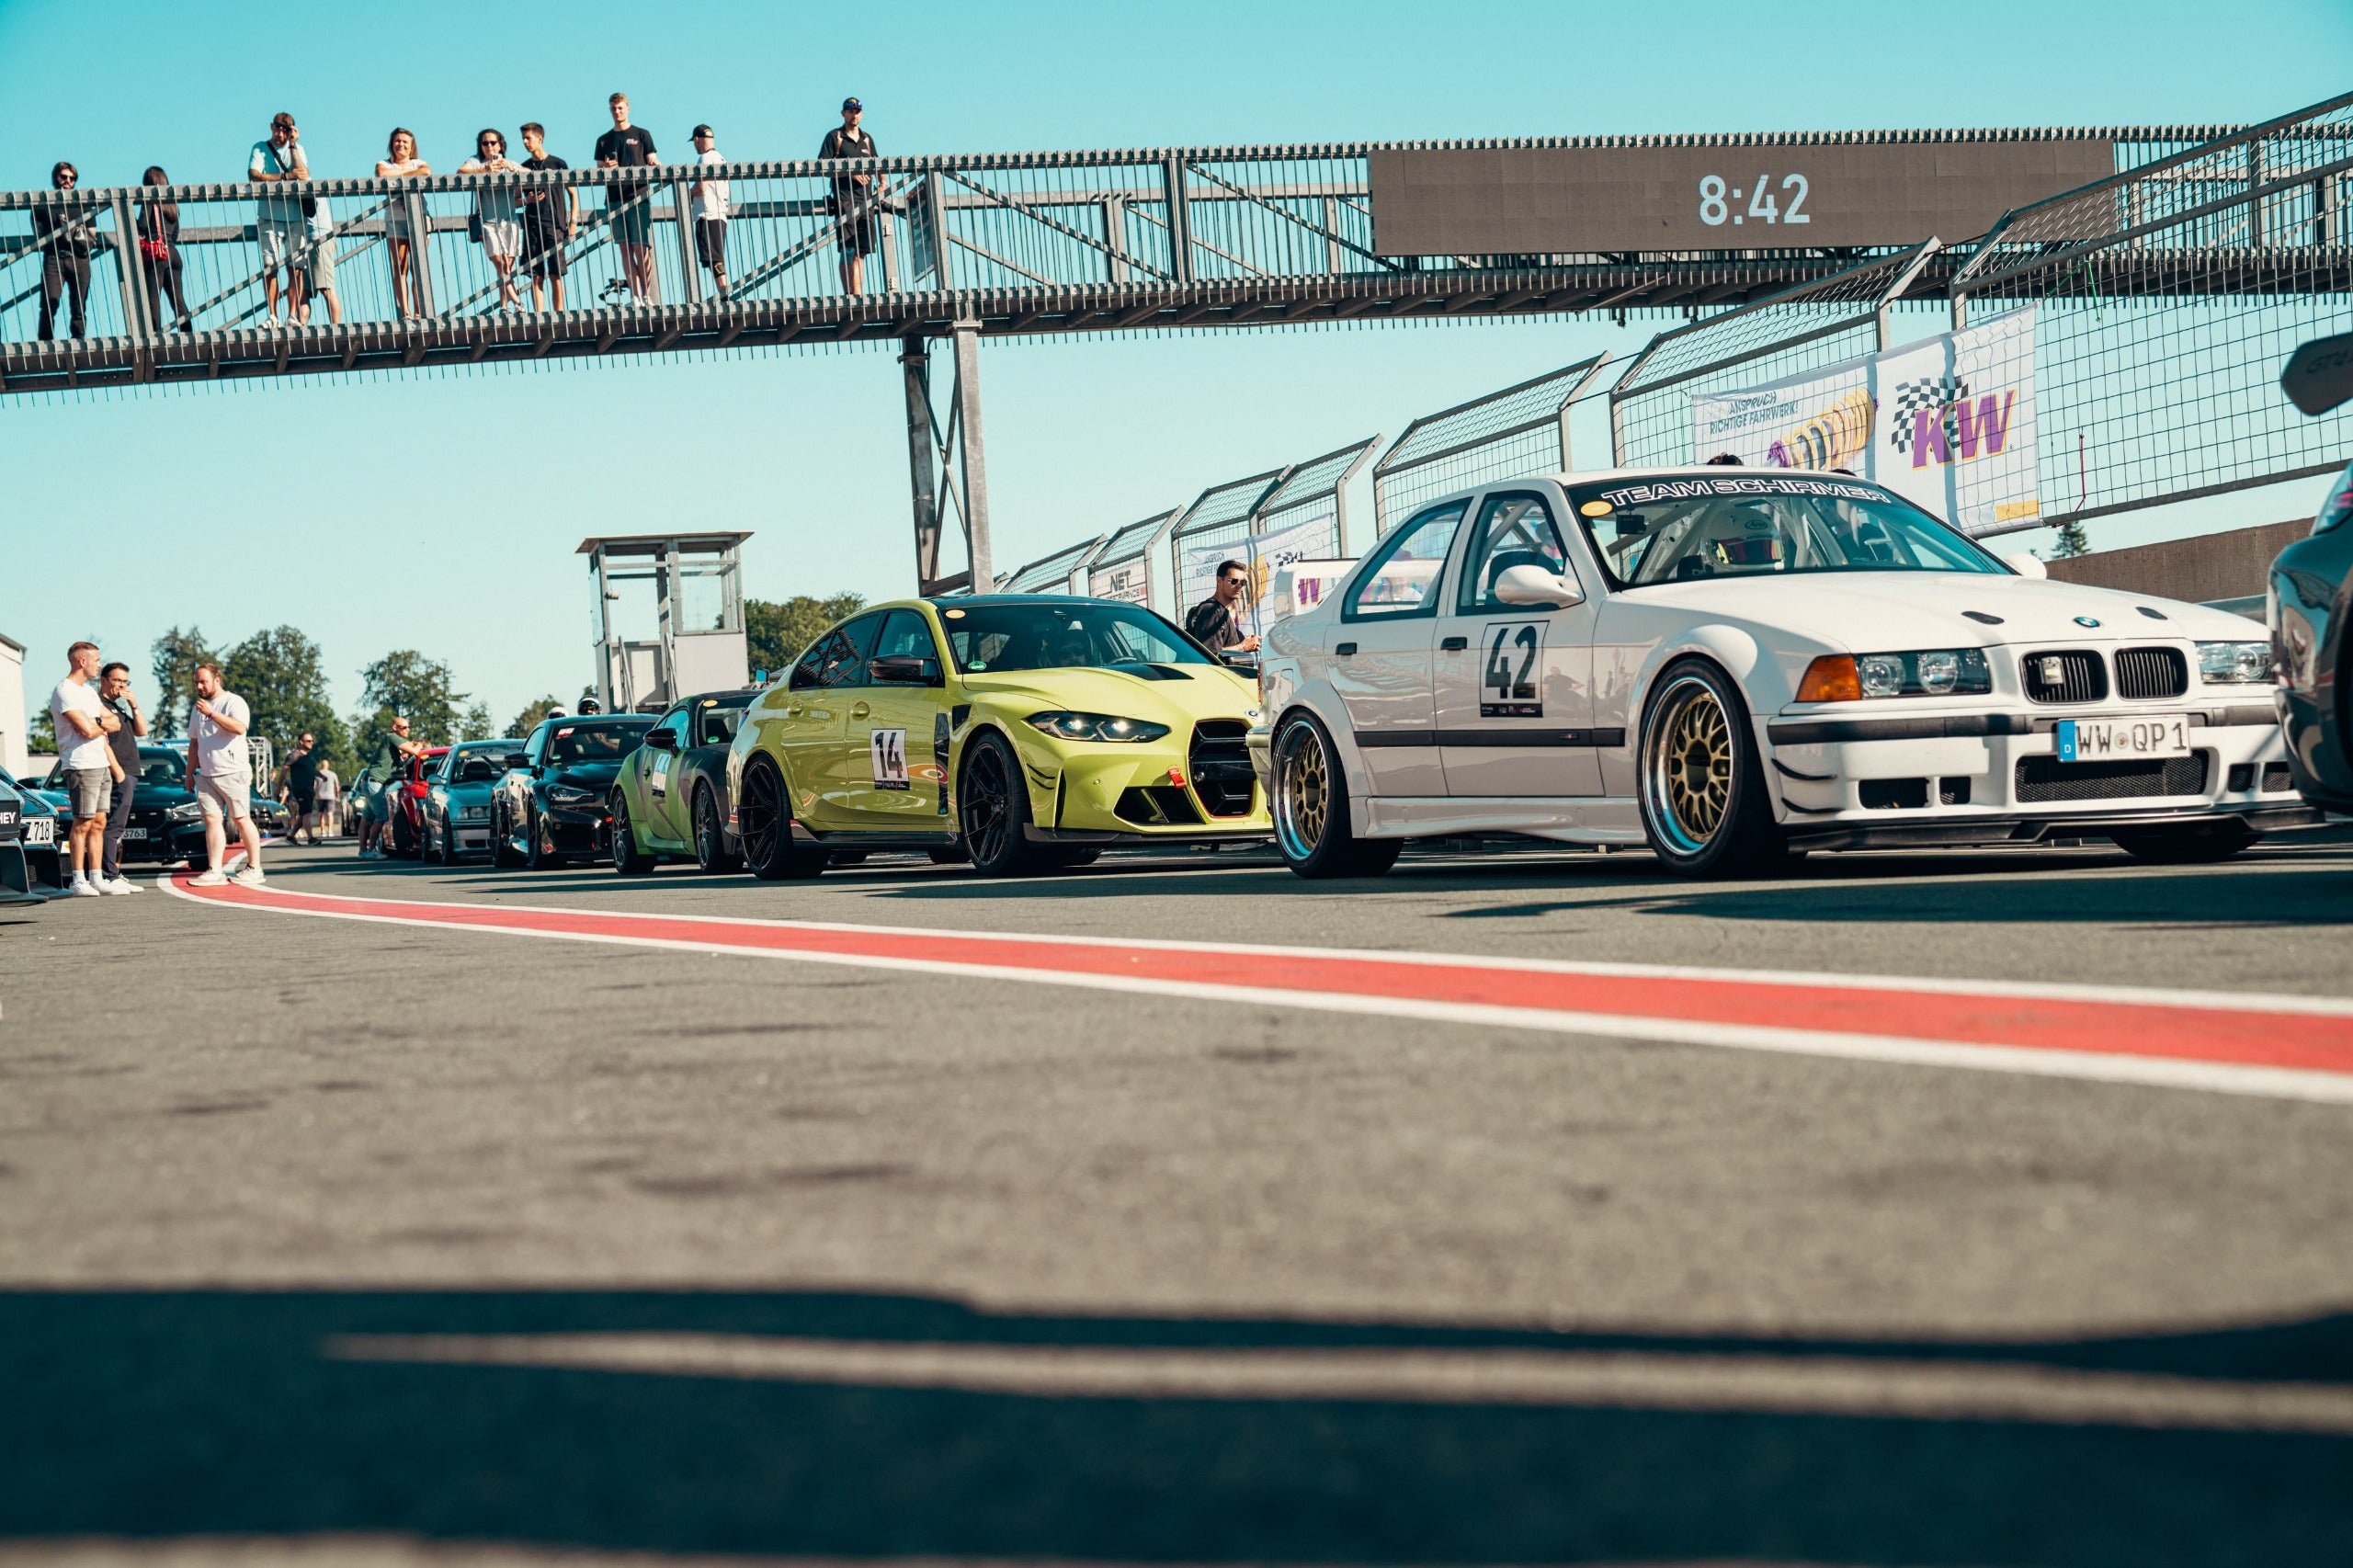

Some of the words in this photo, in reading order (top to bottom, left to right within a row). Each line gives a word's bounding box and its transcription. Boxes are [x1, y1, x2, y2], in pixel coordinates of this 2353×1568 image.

[1699, 174, 1811, 226] 8:42
[1710, 414, 1747, 436] RICHTIGE
[1749, 400, 1799, 426] FAHRWERK!
[1729, 391, 1778, 415] ANSPRUCH
[1912, 388, 2018, 472] KW
[1600, 480, 1713, 507] TEAM
[1710, 478, 1892, 505] SCHIRMER
[1110, 570, 1131, 593] NET
[1485, 625, 1538, 699] 42
[875, 732, 903, 779] 14
[2076, 724, 2111, 755] WW
[2132, 722, 2165, 752] QP
[2172, 722, 2187, 751] 1
[34, 821, 51, 841] 718
